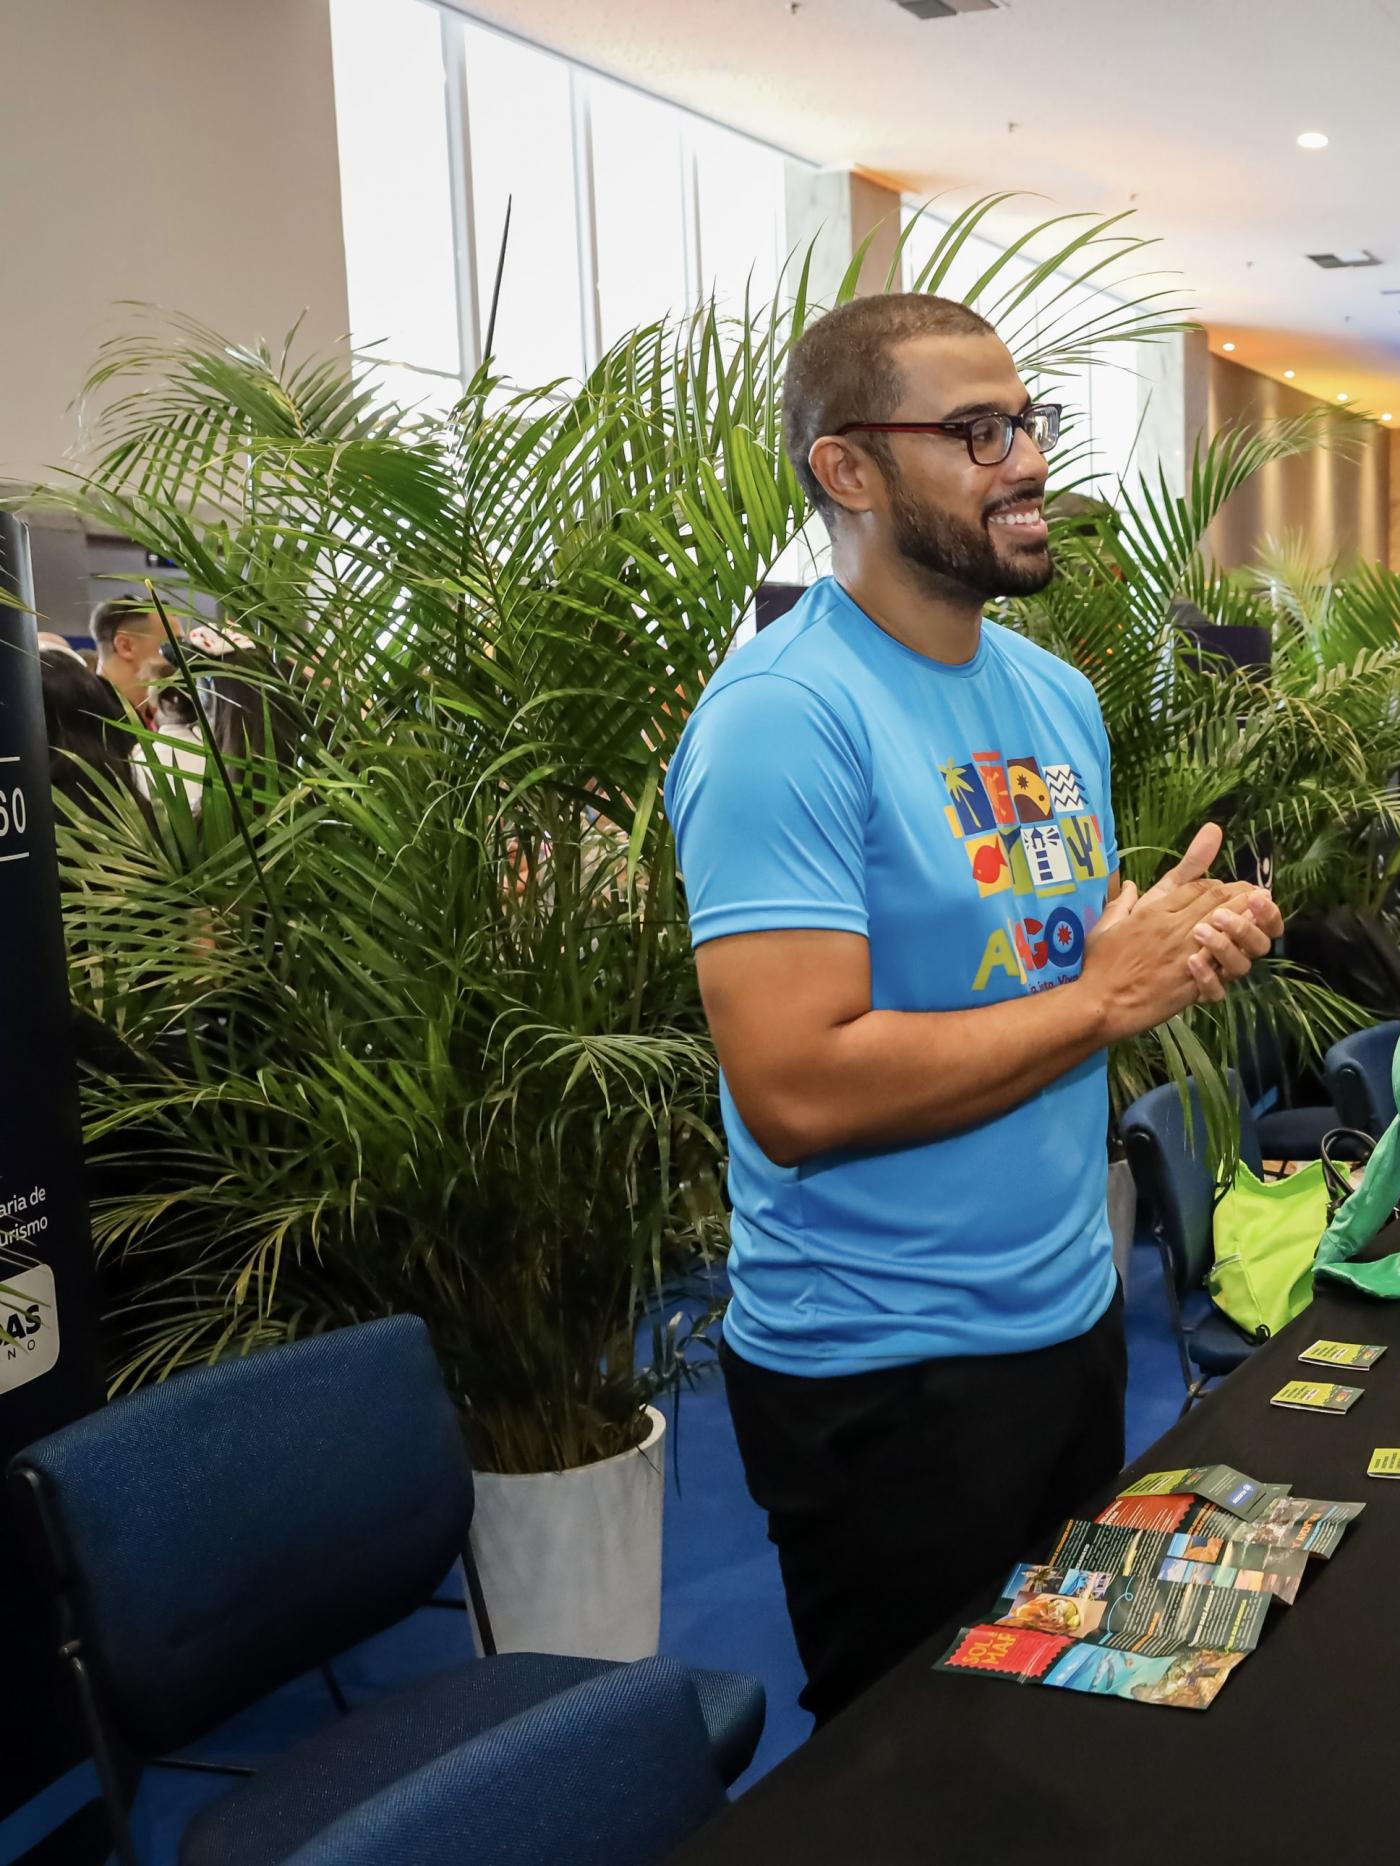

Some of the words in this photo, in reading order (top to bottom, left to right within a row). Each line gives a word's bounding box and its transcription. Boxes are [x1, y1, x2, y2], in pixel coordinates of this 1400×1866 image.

[0, 1195, 27, 1217] aria
[30, 1186, 46, 1206] de
[0, 1216, 48, 1247] urismo
[0, 1304, 41, 1346] AS
[962, 1639, 993, 1664] SOL
